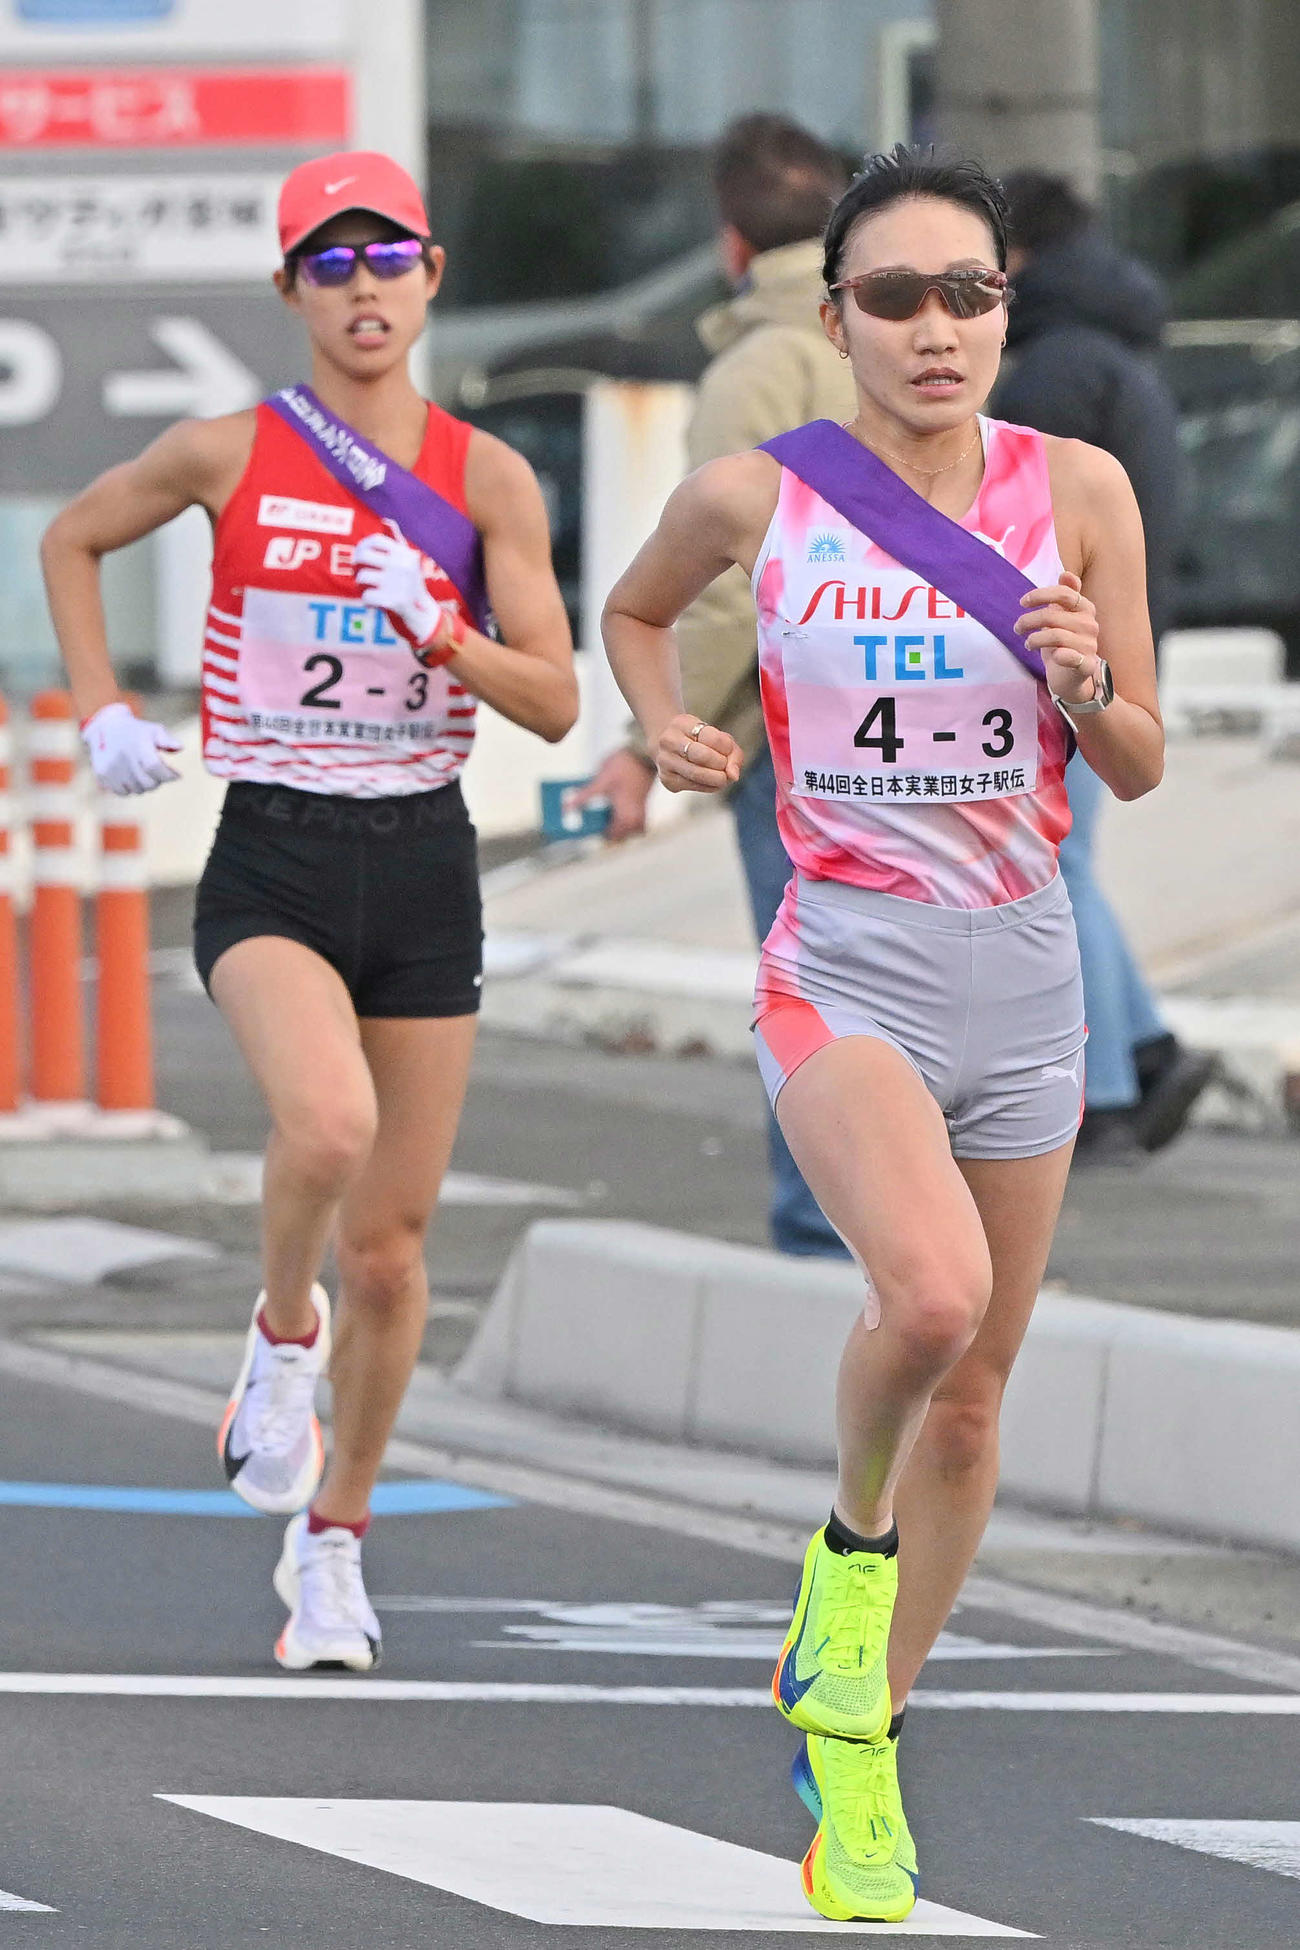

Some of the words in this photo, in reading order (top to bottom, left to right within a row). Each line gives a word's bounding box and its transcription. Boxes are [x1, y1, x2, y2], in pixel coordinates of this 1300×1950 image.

[806, 553, 846, 564] ANESSA
[307, 602, 397, 647] TEL
[853, 635, 964, 680] TEL
[803, 768, 1026, 797] 第44回全日本実業団女子駅伝
